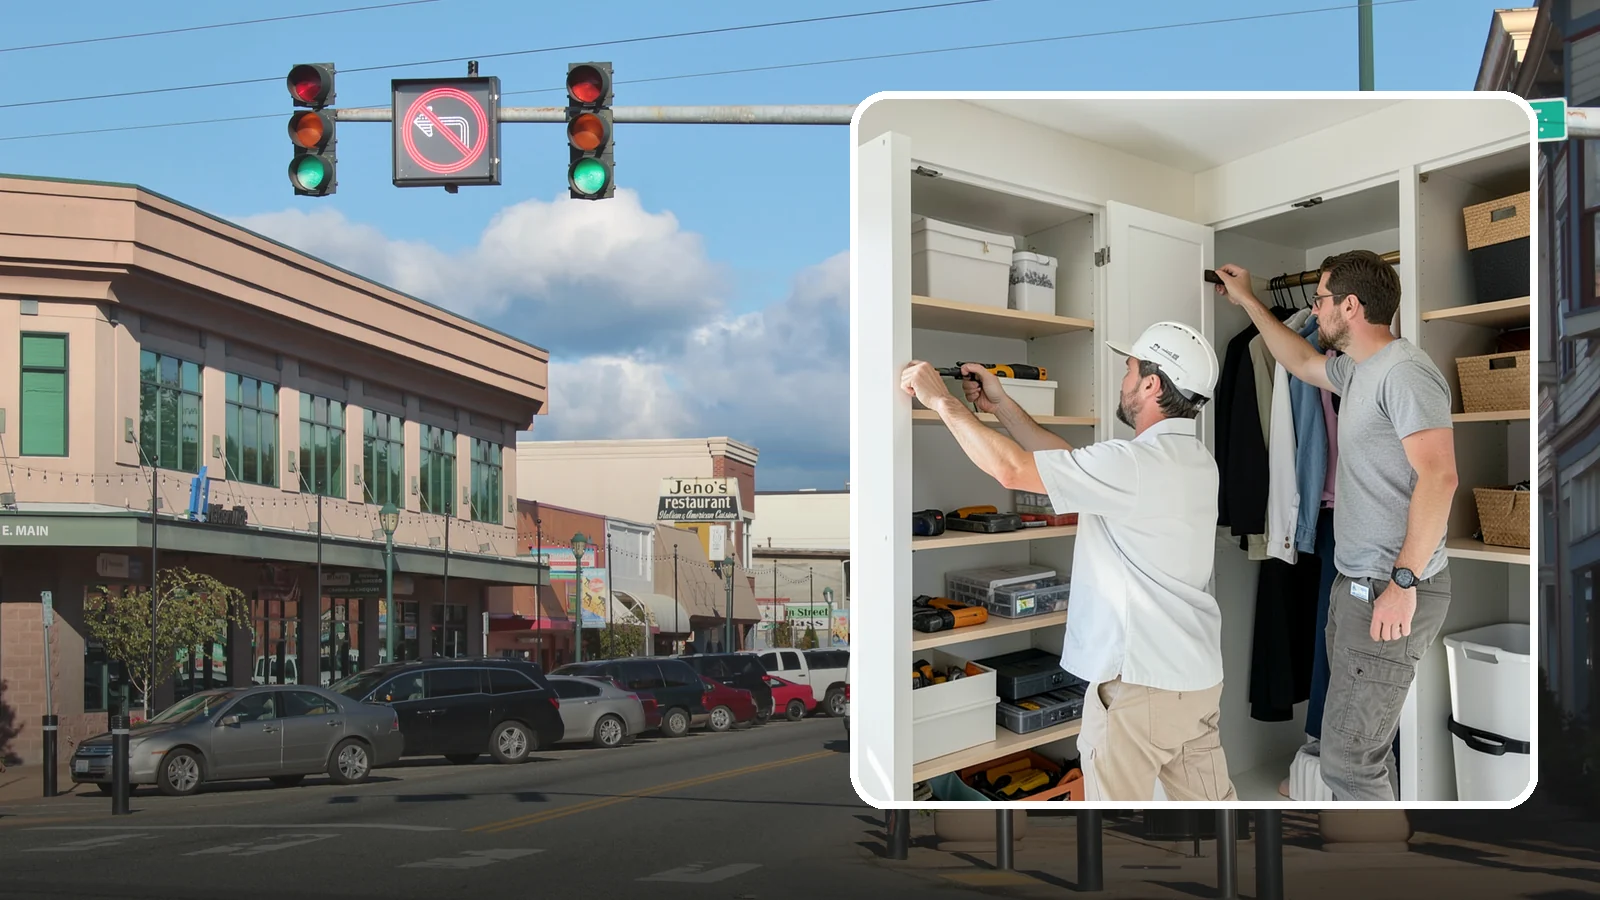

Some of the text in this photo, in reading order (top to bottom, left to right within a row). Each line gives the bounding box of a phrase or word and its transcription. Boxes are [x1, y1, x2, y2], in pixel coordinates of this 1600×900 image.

[669, 480, 727, 494] Jeno's
[665, 496, 731, 509] restaurant
[685, 510, 714, 519] American
[714, 509, 737, 519] Cuisine
[2, 525, 49, 536] E. MAIN
[797, 608, 828, 617] Street
[791, 619, 824, 627] lass
